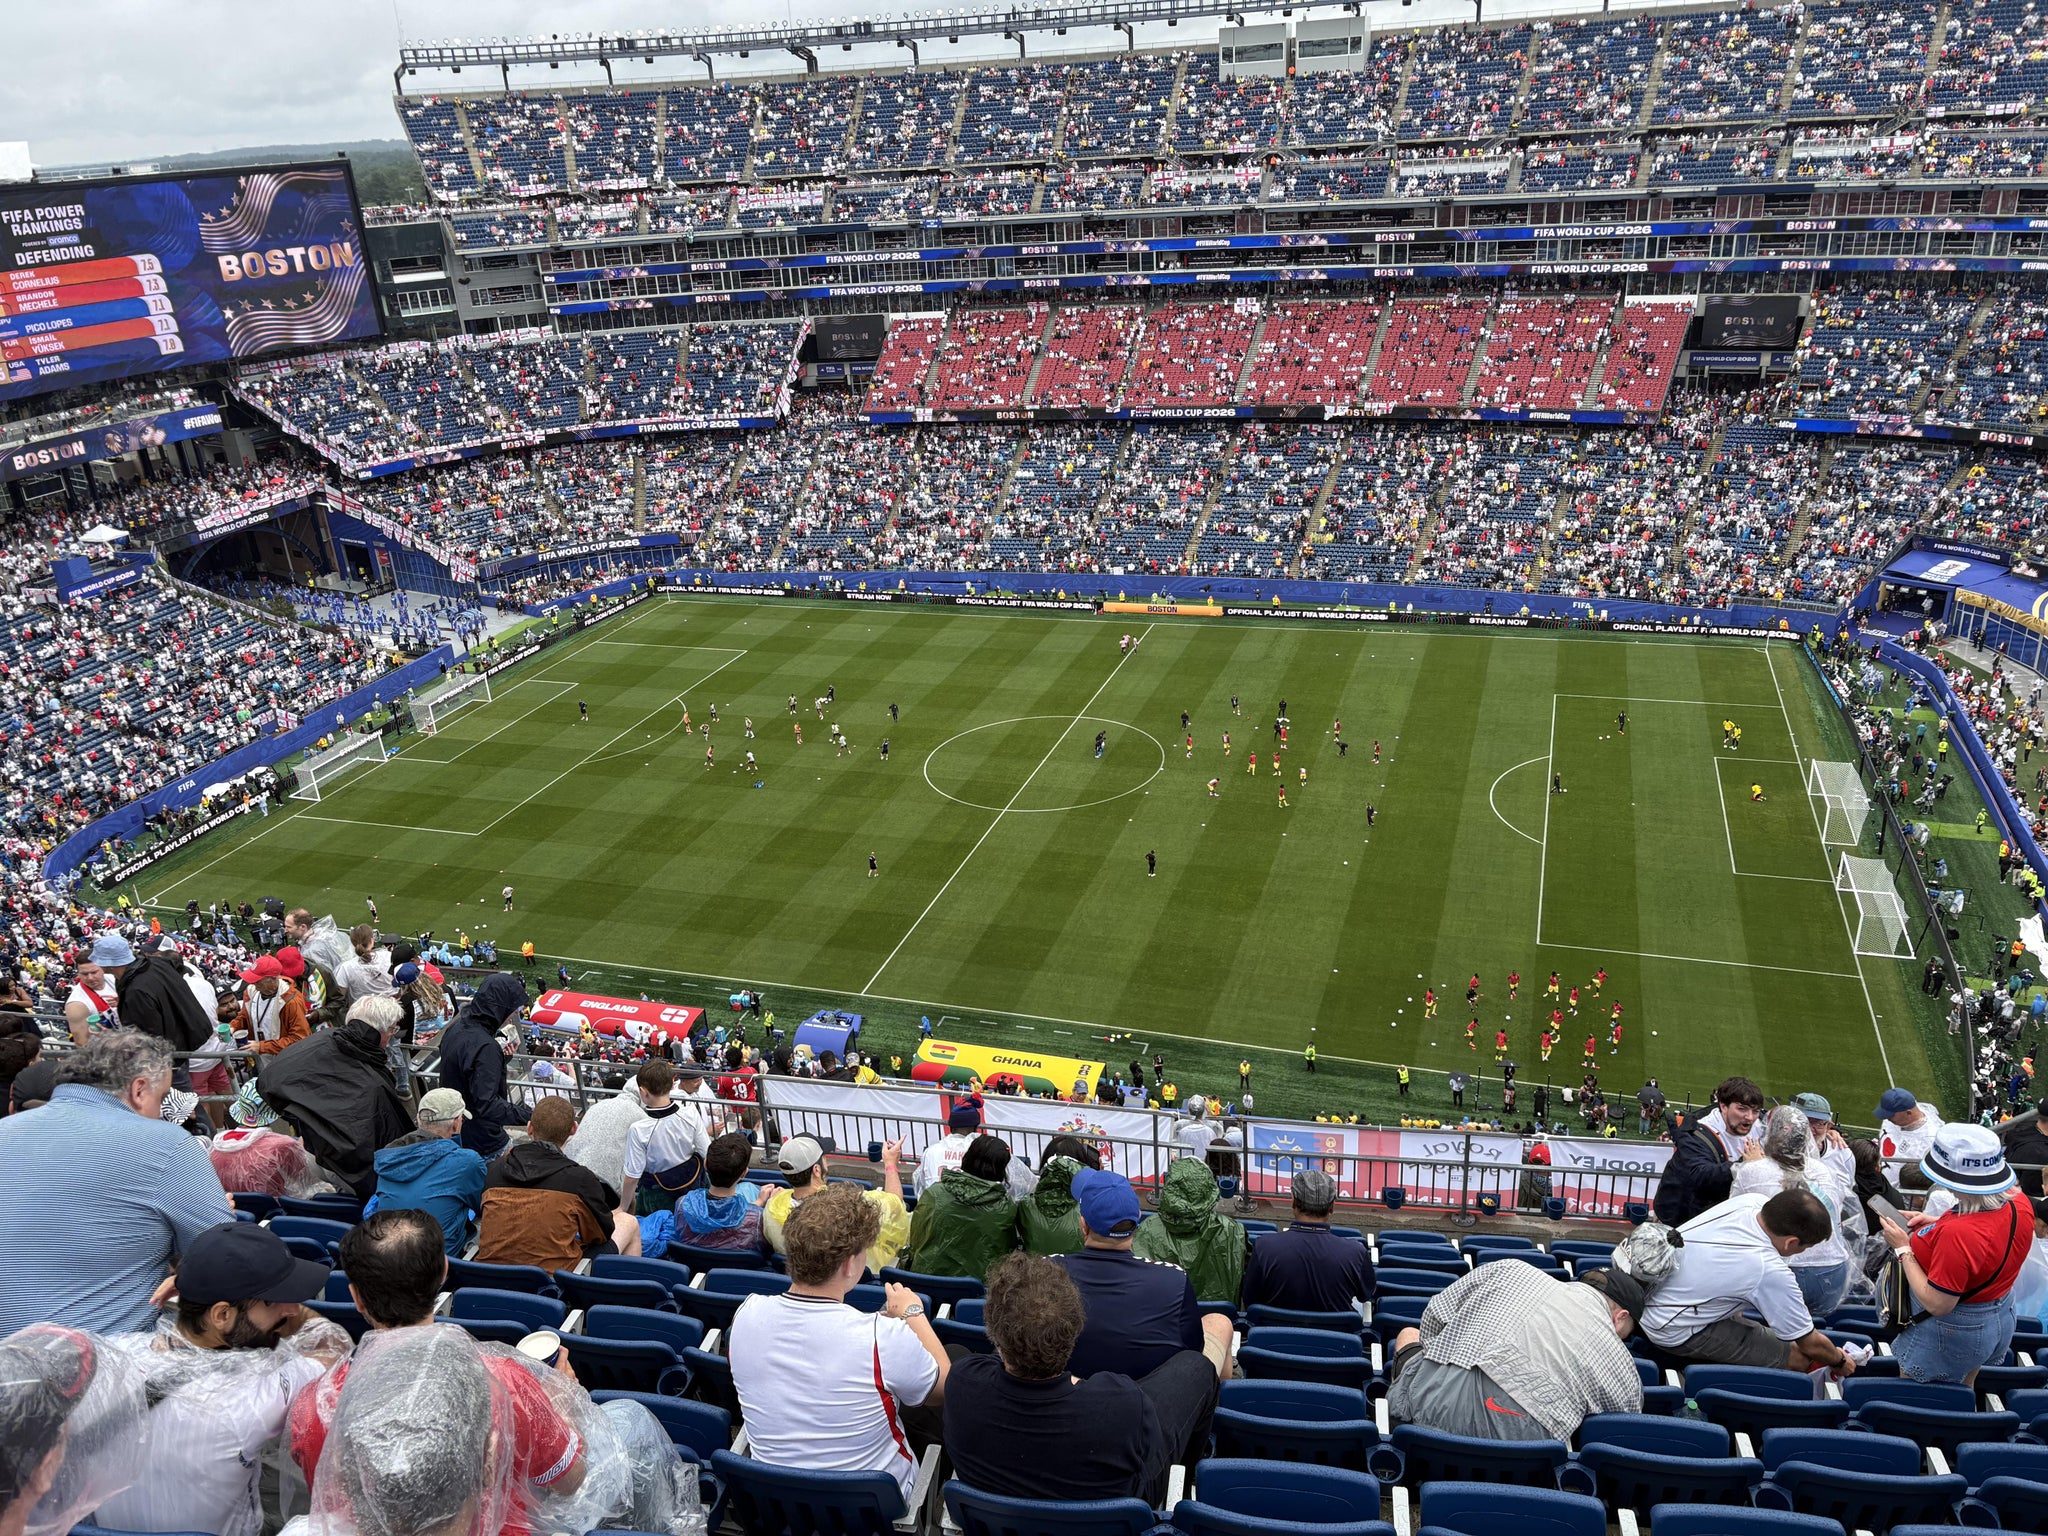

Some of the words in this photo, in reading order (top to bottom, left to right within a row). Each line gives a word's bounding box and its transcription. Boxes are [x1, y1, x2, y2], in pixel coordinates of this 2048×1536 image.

[1, 208, 33, 224] FIFA
[36, 204, 85, 220] POWER
[11, 217, 83, 236] RANKINGS
[1786, 220, 1836, 230] BOSTON
[1375, 232, 1415, 242] BOSTON
[1534, 228, 1554, 237] FIFA
[1556, 227, 1592, 236] WORLD
[1594, 227, 1614, 236] CUP
[1615, 226, 1652, 235] 2026
[49, 236, 78, 245] aramco
[15, 244, 95, 266] DEFENDING
[1022, 246, 1058, 254] BOSTON
[218, 242, 355, 282] BOSTON
[826, 255, 844, 264] FIFA
[845, 254, 873, 262] WORLD
[874, 254, 890, 262] CUP
[892, 252, 920, 260] 2026
[141, 258, 154, 272] 7.5
[691, 261, 726, 271] BOSTON
[1532, 264, 1552, 274] FIFA
[1553, 264, 1588, 274] WORLD
[1590, 264, 1610, 273] CUP
[1612, 264, 1648, 272] 2026
[1781, 261, 1830, 270] BOSTON
[10, 270, 36, 280] DEREK
[1374, 268, 1414, 277] BOSTON
[12, 276, 60, 290] CORNELIUS
[146, 278, 160, 292] 7.3
[1024, 278, 1060, 288] BOSTON
[830, 288, 847, 296] FIFA
[848, 286, 876, 295] WORLD
[894, 284, 923, 292] 2026
[16, 292, 55, 302] BRANDON
[696, 293, 730, 302] BOSTON
[18, 298, 59, 312] MECHELE
[154, 299, 166, 312] 7.1
[25, 321, 47, 334] PICO
[48, 318, 74, 331] LOPES
[158, 319, 170, 332] 7.1
[1724, 316, 1774, 326] BOSTON
[832, 332, 868, 342] BOSTON
[3, 339, 19, 348] TUR
[163, 338, 176, 351] 7.8
[8, 361, 26, 369] USA
[36, 356, 60, 366] TYLER
[38, 362, 70, 376] ADAMS
[996, 411, 1034, 420] BOSTON
[1151, 409, 1182, 418] WORLD
[1184, 409, 1202, 417] CUP
[1204, 408, 1236, 417] 2026
[638, 424, 658, 433] FIFA
[659, 422, 690, 432] WORLD
[691, 421, 708, 430] CUP
[710, 419, 740, 428] 2026
[1979, 430, 2034, 446] BOSTON
[13, 440, 86, 471] BOSTON
[199, 532, 214, 540] FIFA
[214, 524, 236, 536] WORLD
[236, 519, 248, 528] CUP
[248, 512, 269, 524] 2026
[538, 550, 555, 562] FIFA
[556, 545, 588, 558] WORLD
[590, 542, 608, 552] CUP
[608, 538, 640, 549] 2026
[1948, 545, 1970, 554] WORLD
[1982, 552, 2000, 560] 2026
[68, 589, 82, 598] FIFA
[82, 581, 104, 593] WORLD
[103, 577, 114, 586] CUP
[115, 570, 136, 582] 2026
[657, 585, 687, 593] OFFICIAL
[688, 586, 717, 594] PLAYLIST
[956, 598, 987, 606] OFFICIAL
[1572, 601, 1592, 610] FIFA
[1148, 605, 1178, 613] BOSTON
[1228, 608, 1262, 616] OFFICIAL
[1264, 610, 1301, 618] PLAYLIST
[1319, 612, 1344, 620] WORLD
[1469, 616, 1506, 626] STREAM
[1507, 618, 1528, 626] NOW
[1613, 623, 1654, 632] OFFICIAL
[1656, 625, 1698, 634] PLAYLIST
[1720, 628, 1749, 636] WORLD
[1750, 629, 1768, 637] CUP
[498, 658, 514, 670] WORLD
[514, 653, 524, 662] CUP
[178, 779, 196, 794] FIFA
[115, 856, 154, 882] OFFICIAL
[154, 832, 192, 860] PLAYLIST
[193, 823, 210, 838] FIFA
[209, 809, 236, 828] WORLD
[580, 1000, 639, 1014] ENGLAND
[992, 1056, 1042, 1069] GHANA
[732, 1083, 748, 1099] 19
[1962, 1158, 1980, 1167] IT'S
